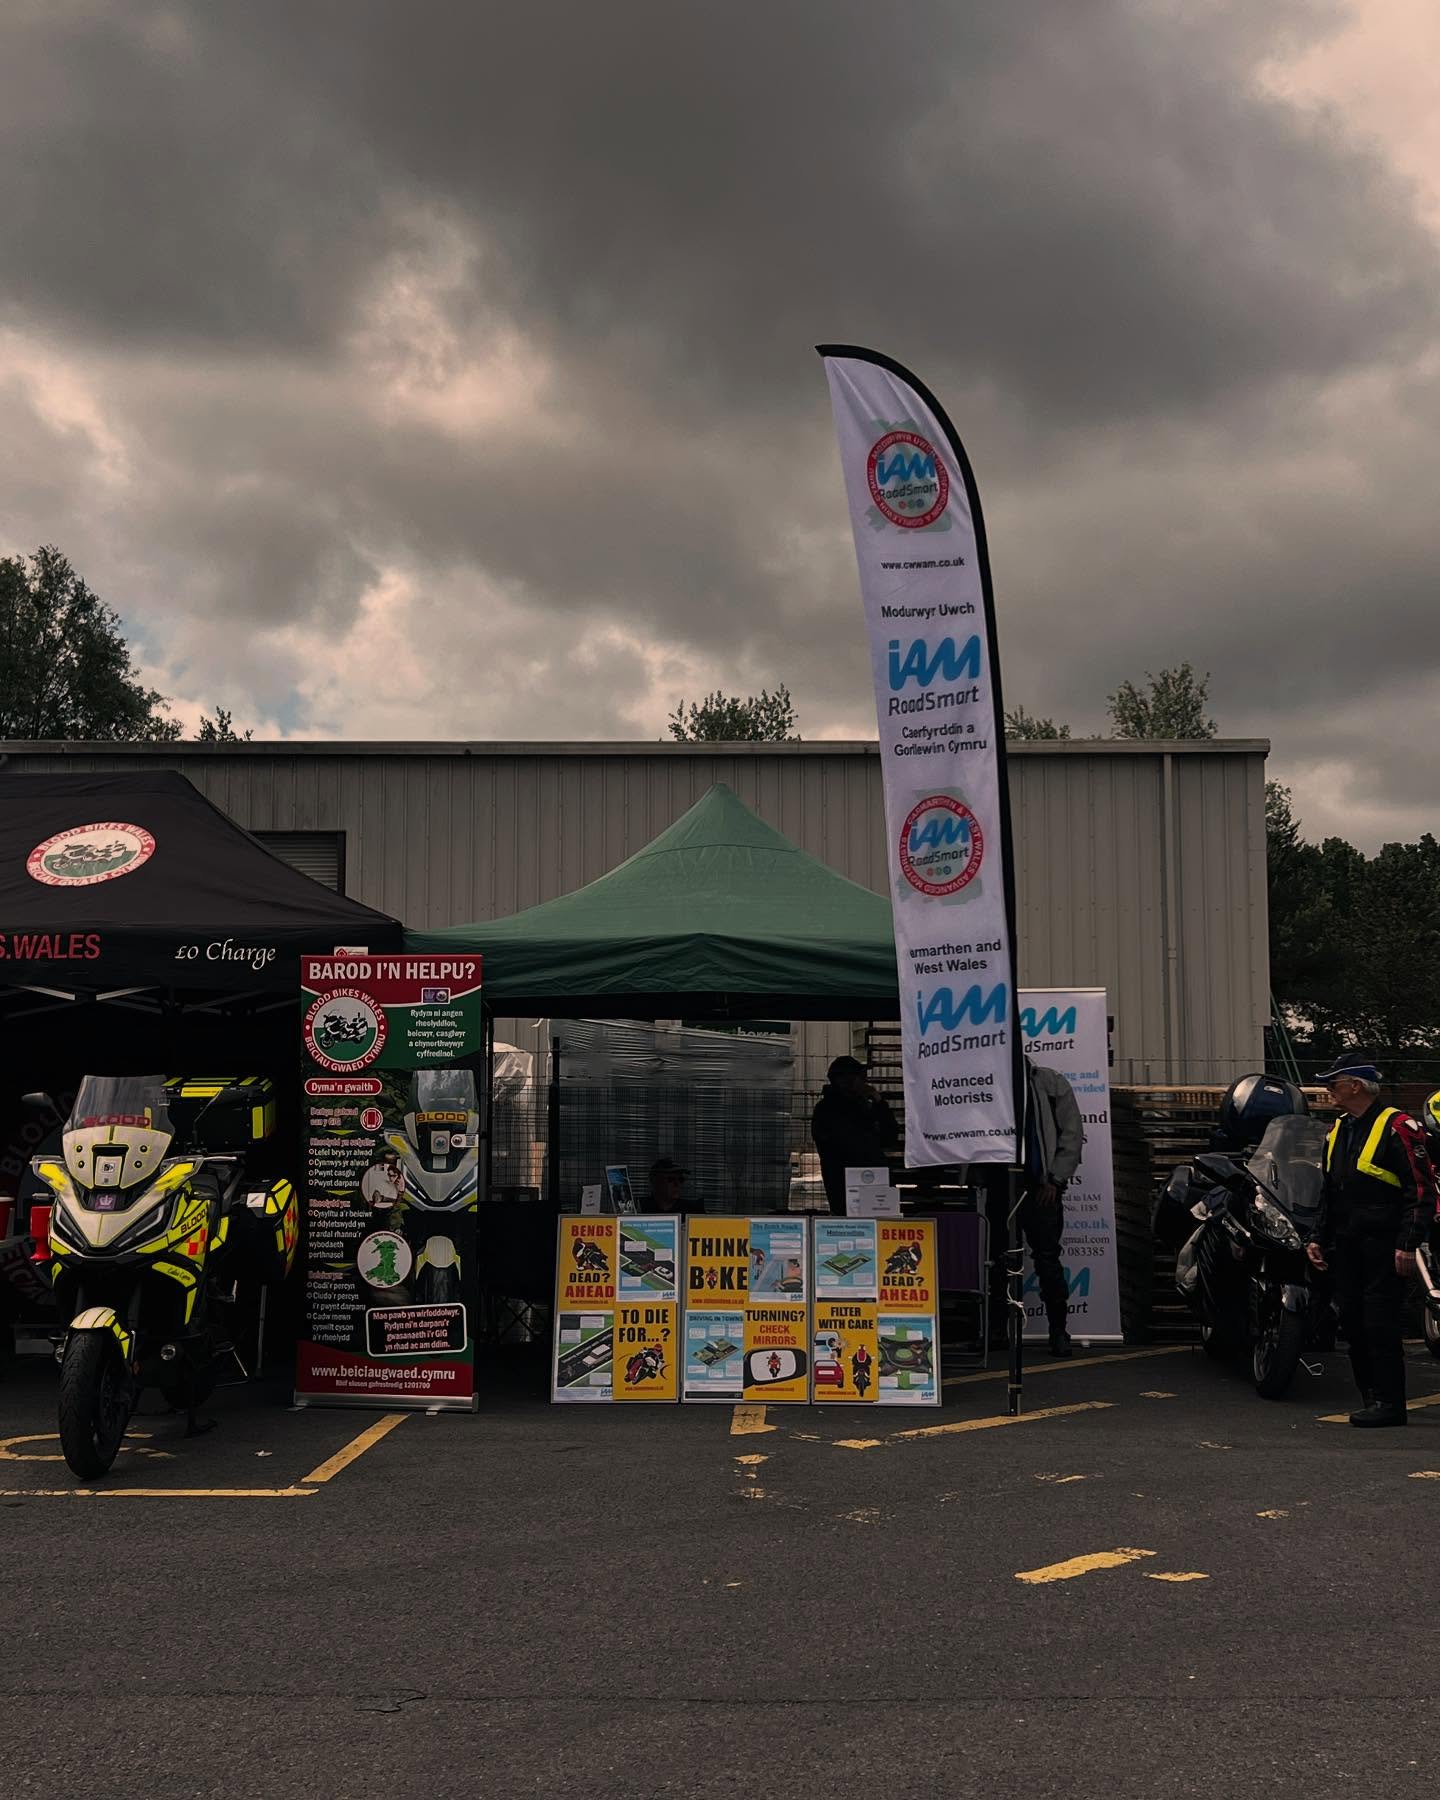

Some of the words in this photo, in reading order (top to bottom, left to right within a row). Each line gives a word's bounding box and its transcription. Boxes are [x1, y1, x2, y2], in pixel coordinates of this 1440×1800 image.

[879, 483, 938, 499] RoadSmart
[881, 557, 965, 570] www.cwwam.co.uk
[881, 605, 936, 620] Modurwyr
[939, 602, 975, 617] Uwch
[888, 686, 980, 716] RoadSmart
[902, 723, 962, 741] Caerfyrddin
[967, 725, 975, 734] a
[894, 742, 945, 757] Gorllewin
[948, 739, 987, 755] Cymru
[908, 847, 969, 866] RoadSmart
[174, 945, 199, 960] £0
[206, 938, 276, 970] Charge
[910, 943, 971, 958] armarthen
[976, 939, 1001, 953] and
[309, 962, 372, 980] BAROD
[377, 962, 400, 980] I'N
[405, 962, 475, 980] HELPU?
[914, 962, 943, 975] West
[946, 959, 988, 972] Wales
[305, 991, 332, 1022] BLOOD
[333, 988, 361, 999] BIKES
[360, 992, 386, 1022] WALES
[410, 1009, 433, 1018] Rydym
[441, 1010, 464, 1018] angen
[1019, 1006, 1077, 1038] AM
[918, 1030, 1006, 1059] RoadSmart
[1024, 1038, 1075, 1053] dSmart
[304, 1035, 333, 1068] BEICIAU
[331, 1060, 364, 1073] GWAED
[364, 1033, 387, 1065] CYMRU
[931, 1073, 993, 1089] Advanced
[311, 1083, 343, 1094] Dyma'n
[344, 1083, 373, 1094] gwaith
[934, 1091, 993, 1107] Motorists
[417, 1112, 467, 1124] BLOOD
[1080, 1110, 1107, 1124] and
[923, 1127, 1016, 1141] www.cwwam.co.uk
[331, 1149, 345, 1159] brys
[1083, 1193, 1101, 1202] IAM
[571, 1225, 613, 1237] BENDS
[882, 1229, 925, 1241] BENDS
[689, 1238, 749, 1257] THINK
[1067, 1247, 1105, 1257] 083385
[569, 1272, 611, 1284] DEAD?
[883, 1276, 925, 1287] DEAD?
[565, 1285, 614, 1298] AHEAD
[879, 1288, 929, 1302] AHEAD
[372, 1312, 388, 1320] Mae
[408, 1311, 416, 1319] yn
[621, 1309, 641, 1324] TO
[644, 1309, 669, 1324] DIE
[745, 1310, 805, 1322] TURNING?
[830, 1306, 862, 1317] FILTER
[759, 1324, 790, 1334] CHECK
[818, 1319, 845, 1329] WITH
[848, 1319, 874, 1329] CARE
[752, 1335, 796, 1345] MIRRORS
[311, 1365, 456, 1382] www.beiciaugwaed.cymru
